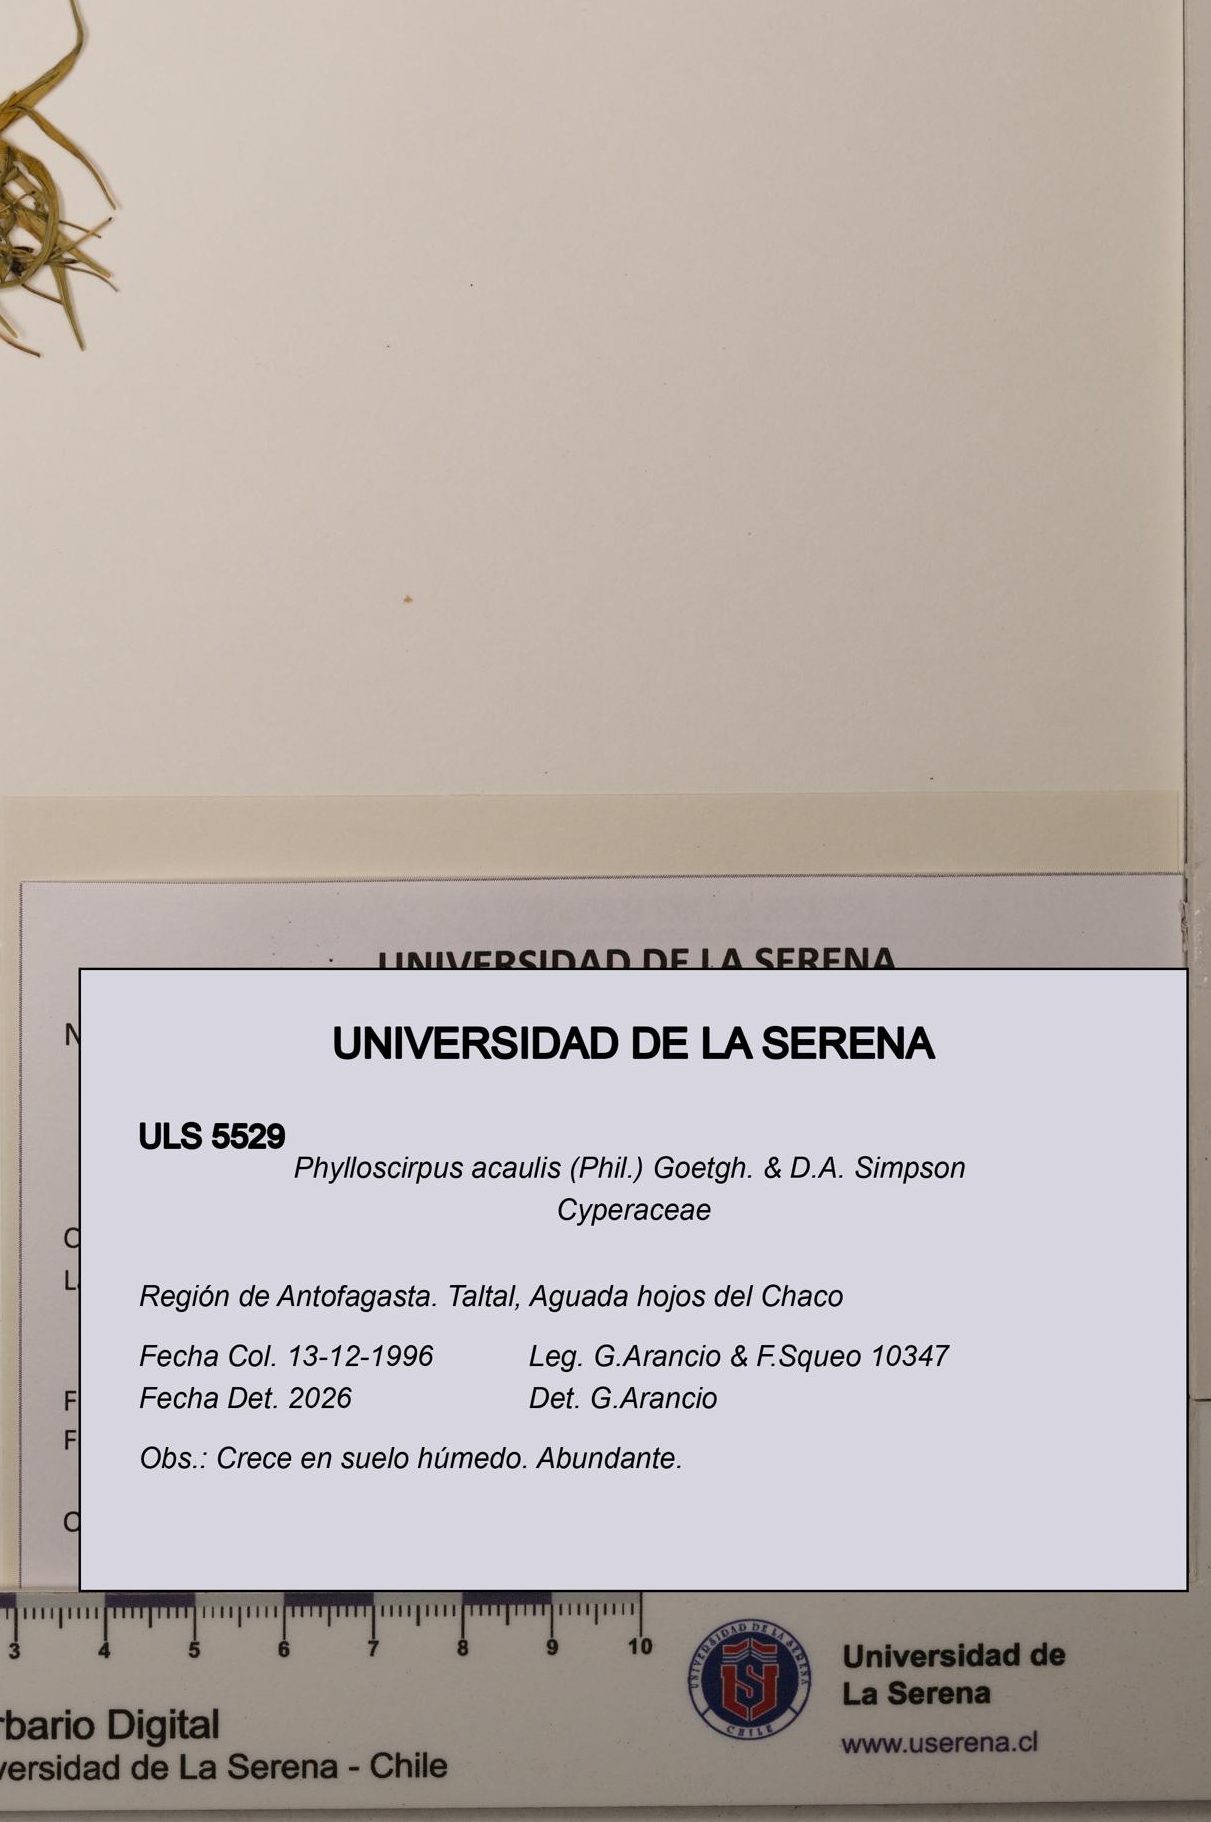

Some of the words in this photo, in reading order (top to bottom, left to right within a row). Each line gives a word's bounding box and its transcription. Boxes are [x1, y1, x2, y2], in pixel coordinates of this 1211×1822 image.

[8, 1642, 21, 1660] 3
[97, 1642, 112, 1659] 4
[188, 1641, 201, 1659] 5
[277, 1640, 291, 1659] 6
[367, 1640, 380, 1658] 7
[456, 1639, 469, 1657] 8
[545, 1639, 560, 1657] 9
[628, 1638, 654, 1656] 10
[691, 1623, 747, 1689] UNIVERSIDAD
[752, 1623, 768, 1634] DE
[843, 1642, 1021, 1669] Universidad
[1029, 1641, 1066, 1667] de
[843, 1681, 878, 1706] La
[887, 1680, 991, 1706] Serena
[108, 1707, 219, 1748] Digital
[841, 1729, 1038, 1754] www.userena.cl
[130, 1753, 169, 1781] de
[179, 1753, 217, 1781] La
[227, 1752, 338, 1781] Serena
[370, 1751, 448, 1779] Chile
